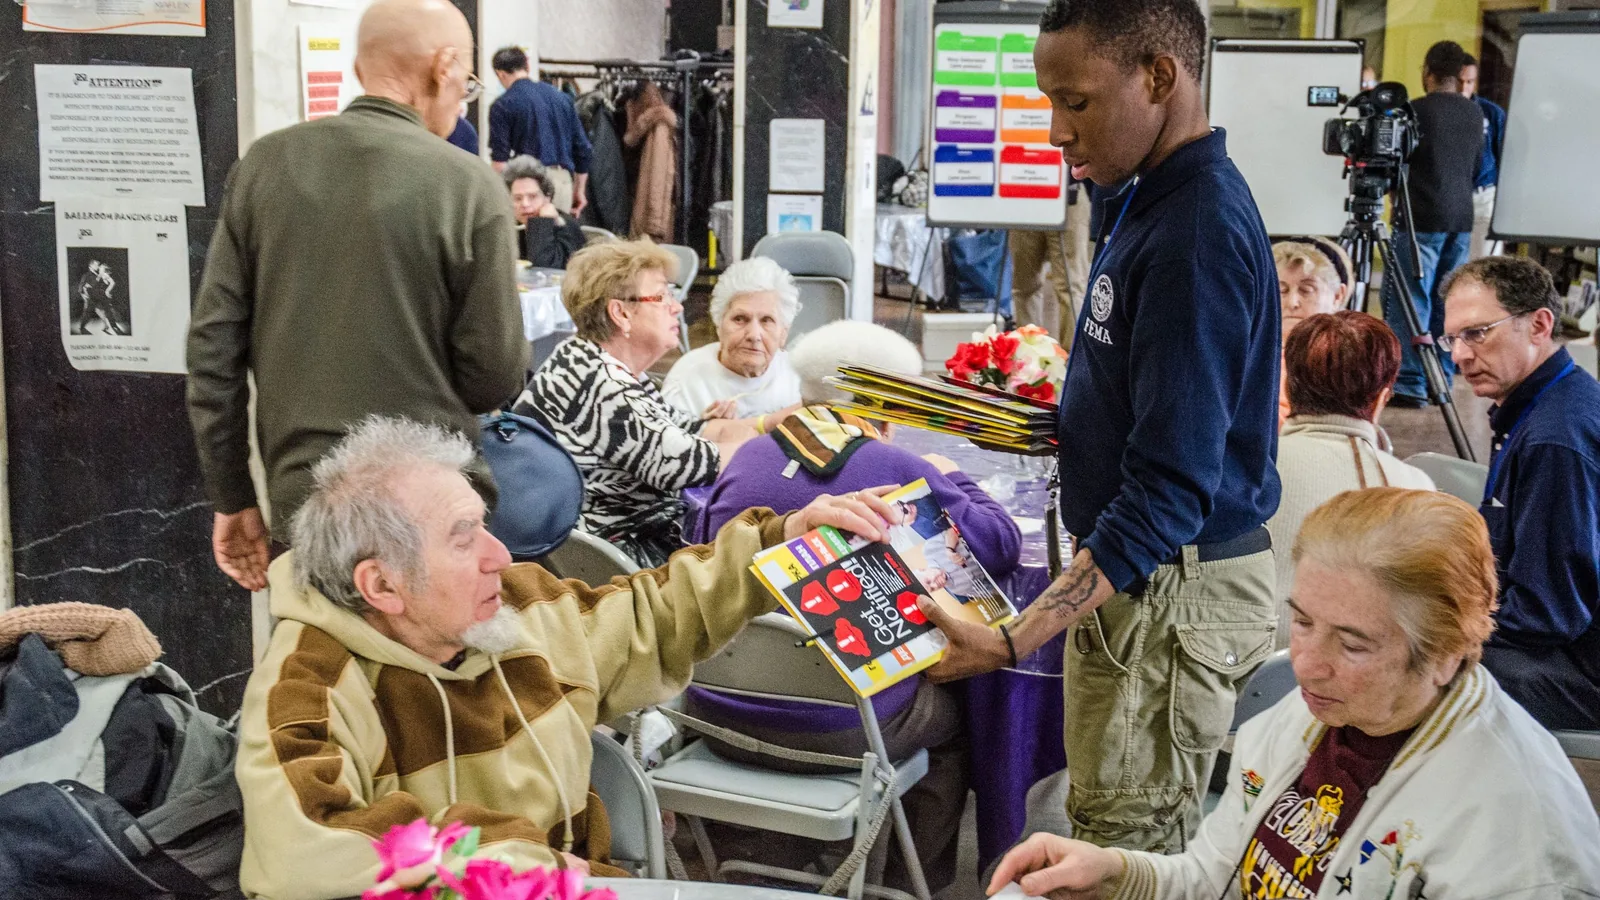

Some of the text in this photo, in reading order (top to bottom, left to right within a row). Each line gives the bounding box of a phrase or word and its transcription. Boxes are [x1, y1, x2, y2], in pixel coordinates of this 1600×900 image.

[89, 79, 151, 89] ATTENTION
[64, 212, 178, 224] BALLROOM DANCING CLASS
[1084, 316, 1113, 344] FEMA
[840, 556, 913, 639] Notified!
[861, 604, 895, 646] Get
